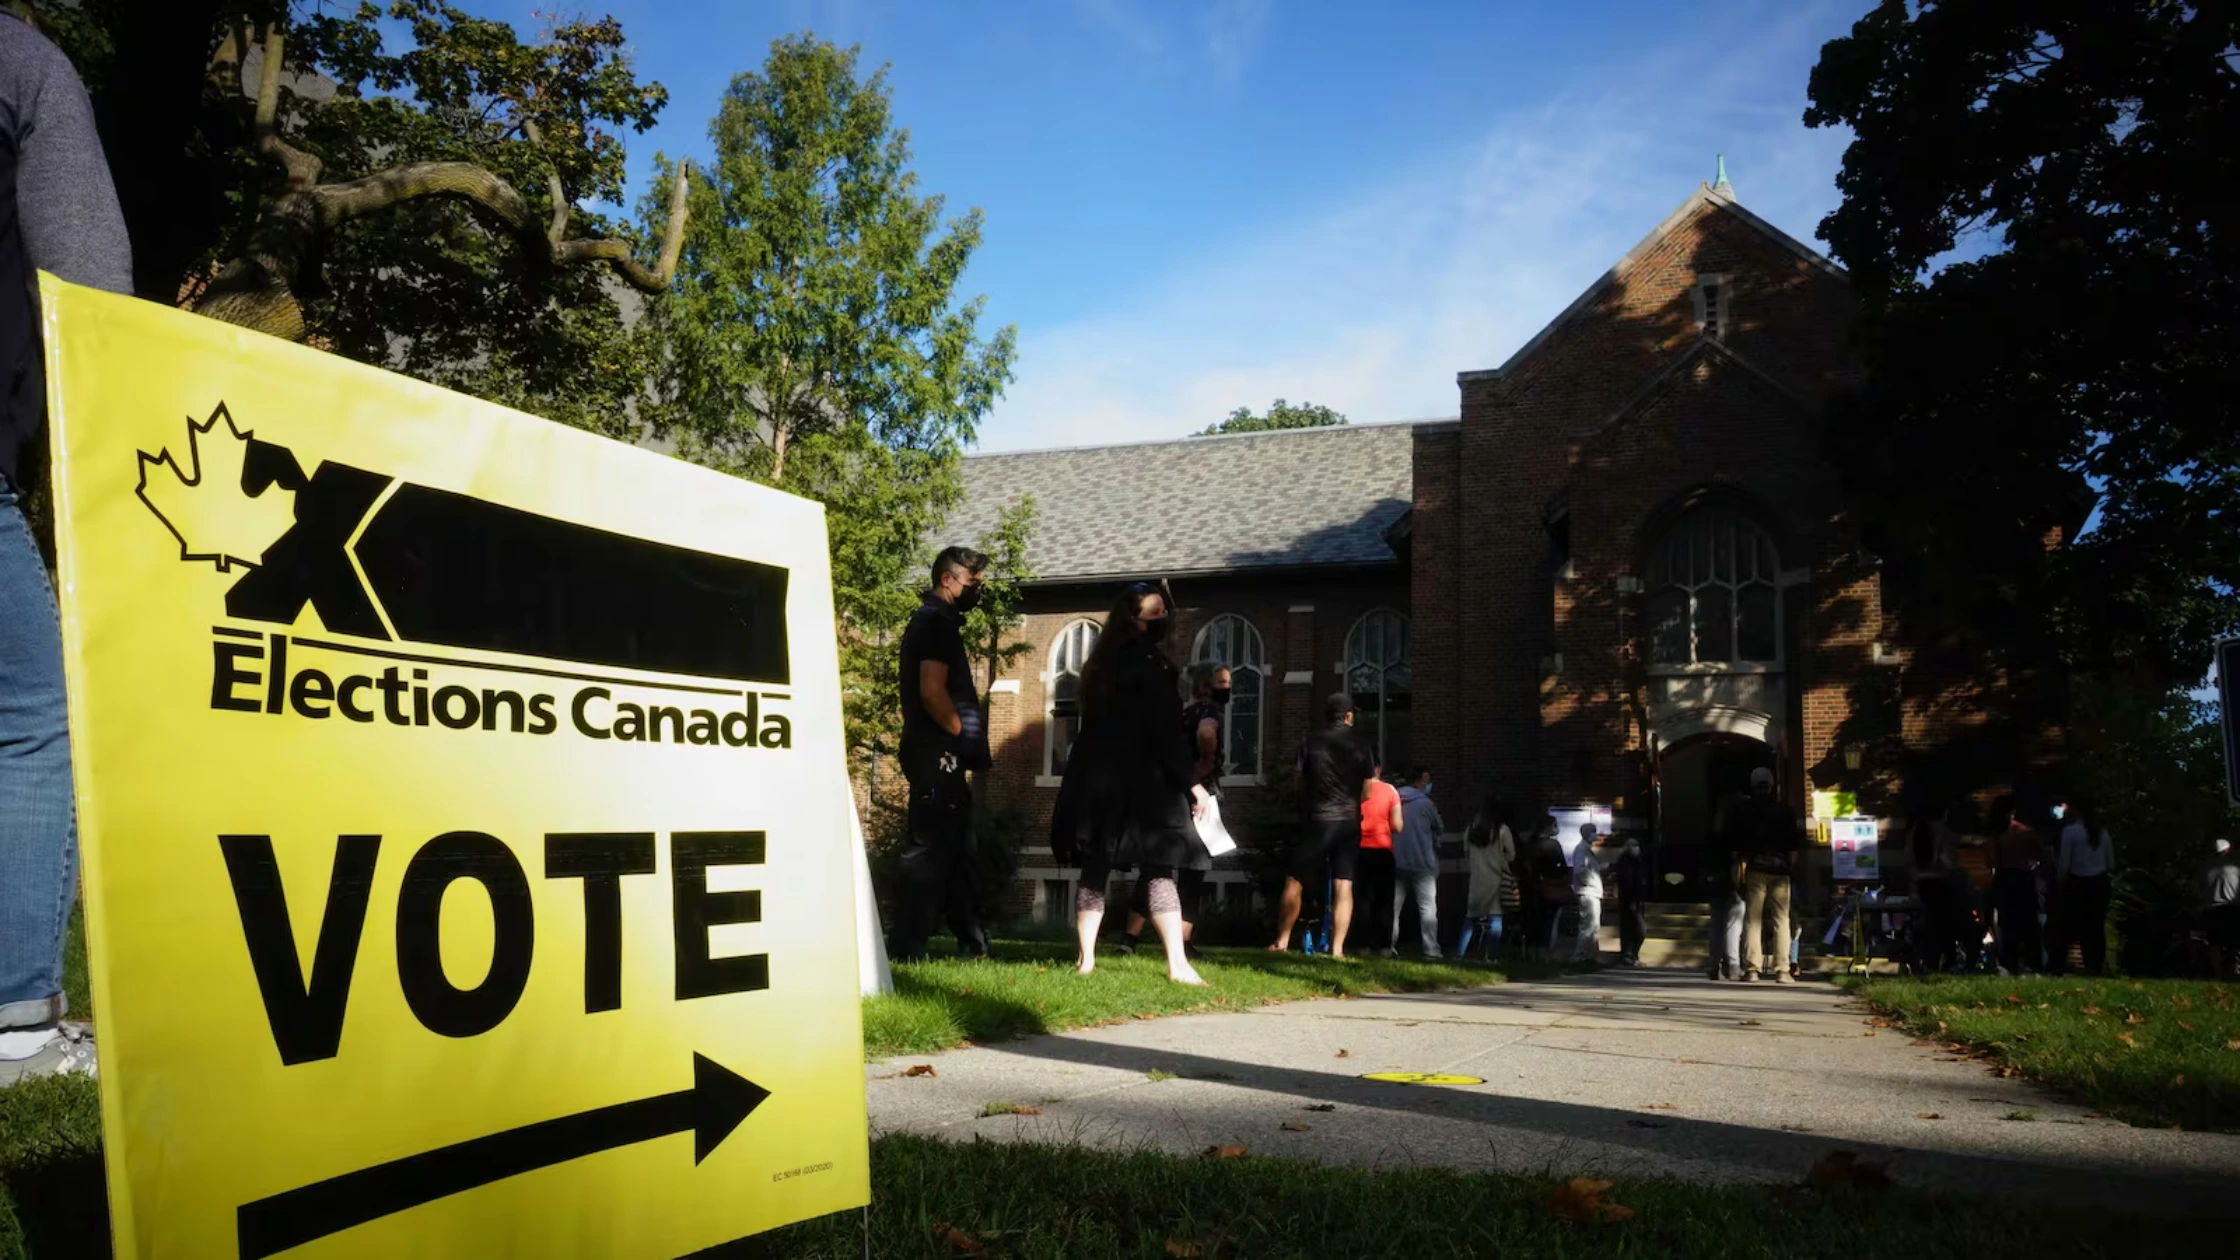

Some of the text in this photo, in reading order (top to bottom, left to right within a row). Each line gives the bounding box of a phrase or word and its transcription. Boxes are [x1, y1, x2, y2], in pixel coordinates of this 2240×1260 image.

[211, 634, 791, 749] Elections Canada
[218, 831, 770, 1067] VOTE
[772, 1172, 782, 1183] EC
